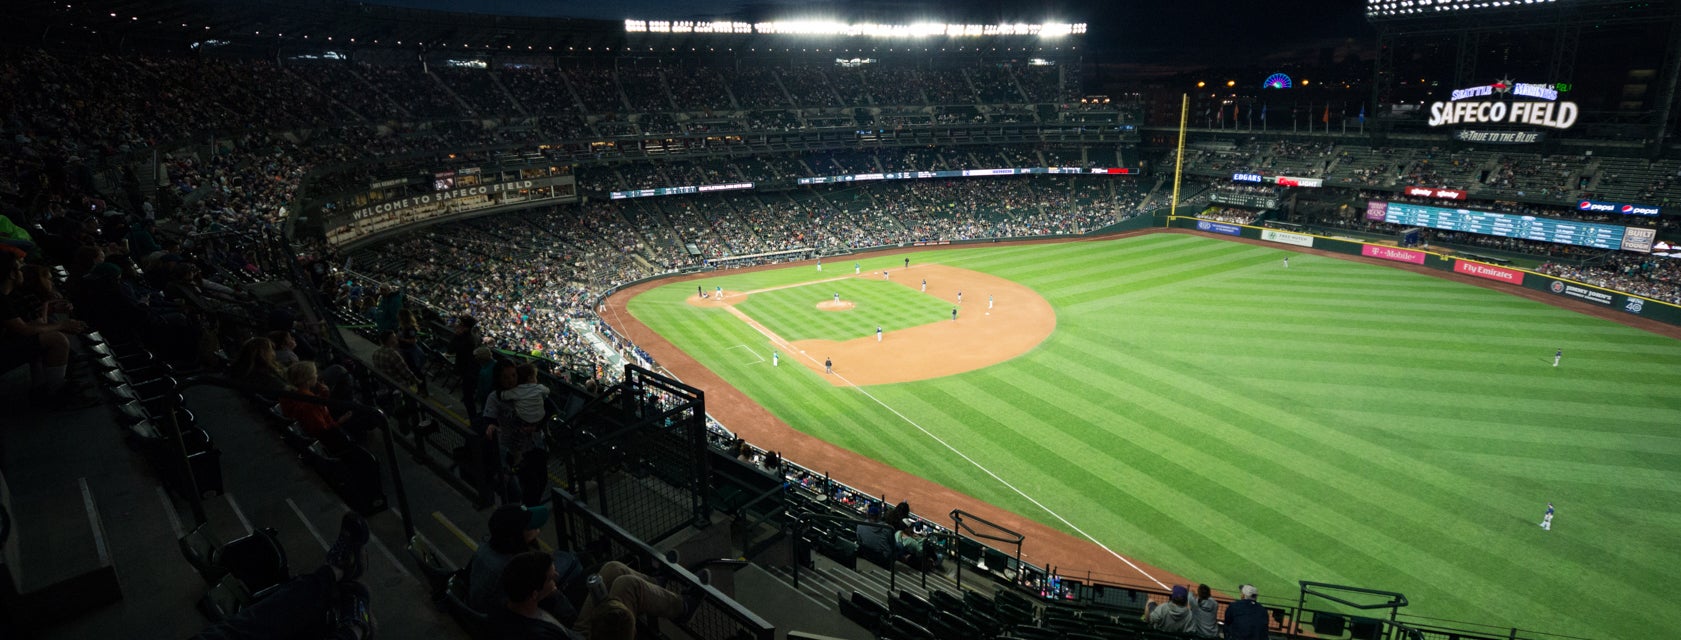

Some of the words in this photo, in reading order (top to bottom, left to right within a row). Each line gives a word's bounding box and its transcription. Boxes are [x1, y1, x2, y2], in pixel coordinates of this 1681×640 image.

[1451, 85, 1493, 101] SEATTLE
[1428, 101, 1507, 127] SAFECO
[1509, 101, 1579, 129] FIELD
[1468, 130, 1488, 141] TRUE
[1488, 131, 1498, 141] TO
[1500, 132, 1515, 142] THE
[1515, 131, 1538, 143] BLUE
[353, 199, 409, 220] WELCOME
[412, 195, 431, 205] TO
[436, 185, 487, 201] SAFECO
[493, 180, 533, 192] FIELD
[1590, 203, 1615, 211] pepsi
[1632, 207, 1659, 215] pepsi
[1628, 229, 1652, 238] BUILT
[1623, 240, 1650, 249] TOUGH
[1463, 263, 1476, 273] Fly
[1477, 266, 1513, 280] Emirates
